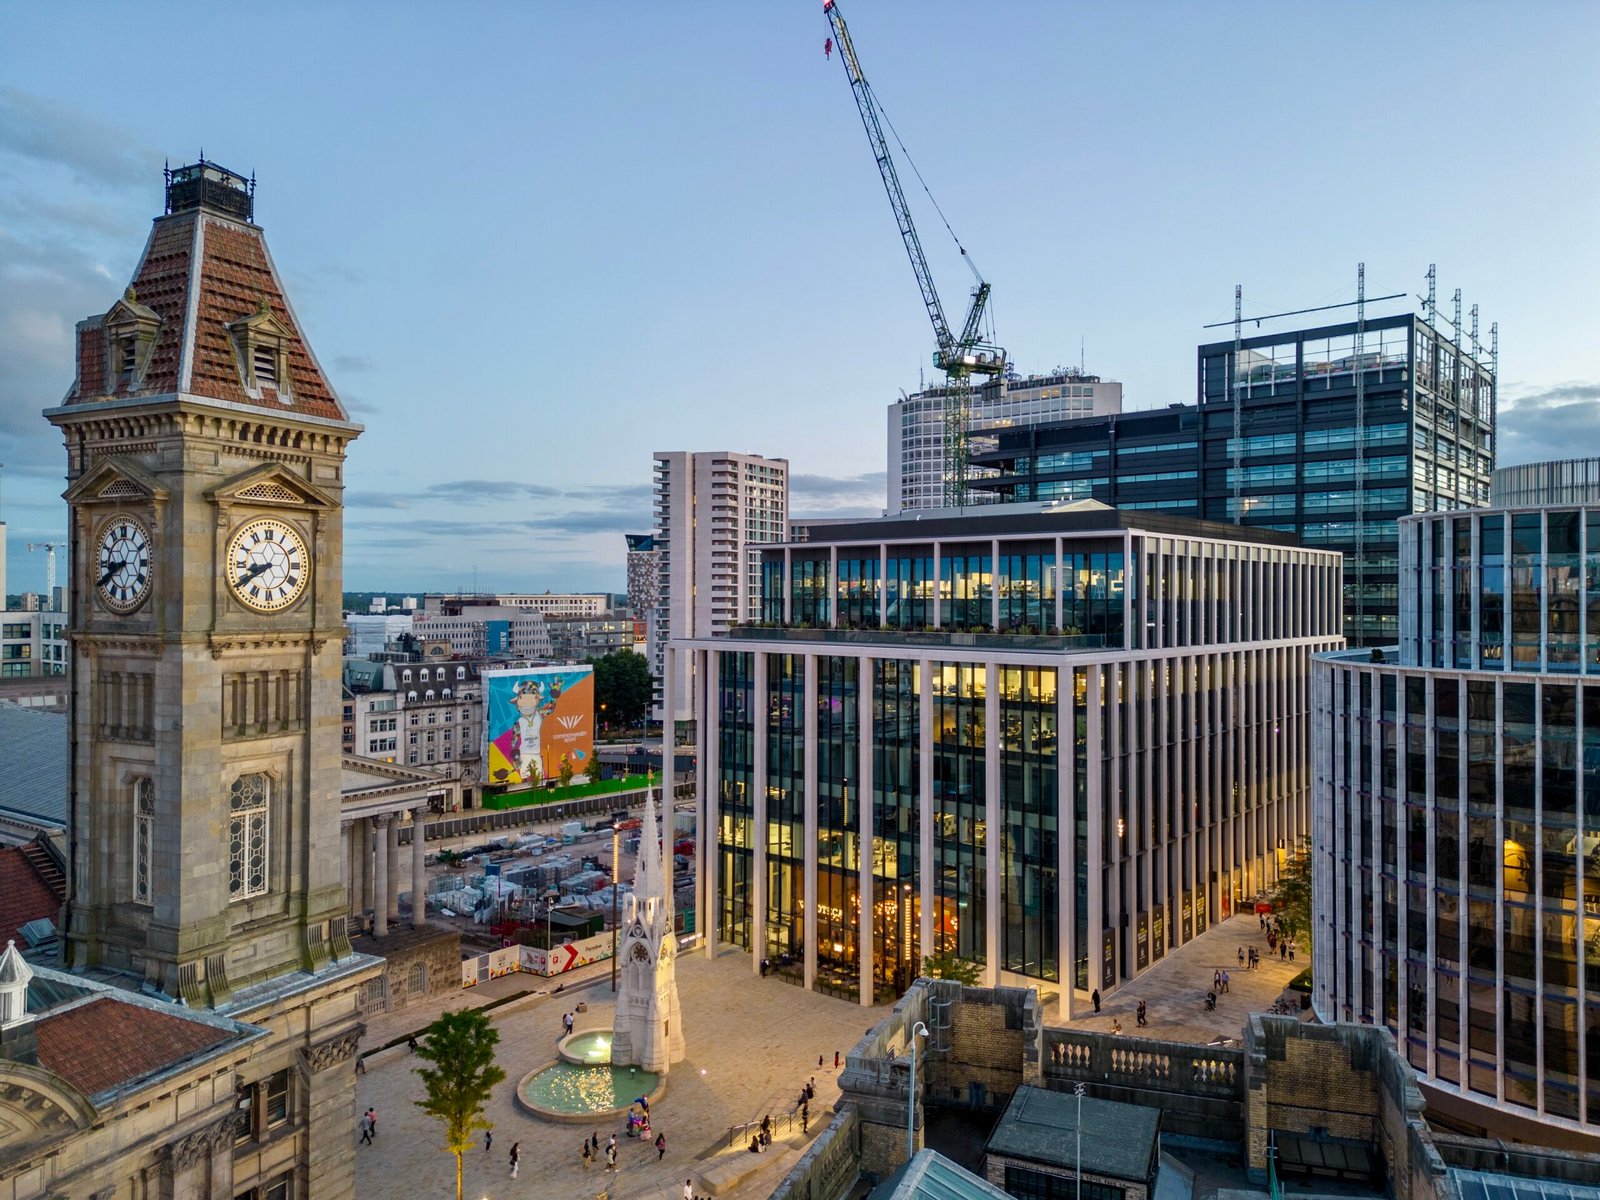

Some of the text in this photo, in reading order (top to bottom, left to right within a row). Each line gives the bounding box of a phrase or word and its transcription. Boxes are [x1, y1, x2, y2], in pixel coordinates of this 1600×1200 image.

[250, 532, 261, 545] XI
[264, 529, 273, 540] XII
[279, 534, 286, 544] I
[240, 544, 251, 554] X
[287, 546, 297, 555] II
[236, 560, 247, 569] IX
[291, 562, 300, 570] III
[249, 585, 260, 598] VII
[265, 590, 273, 601] VI
[279, 587, 287, 598] V
